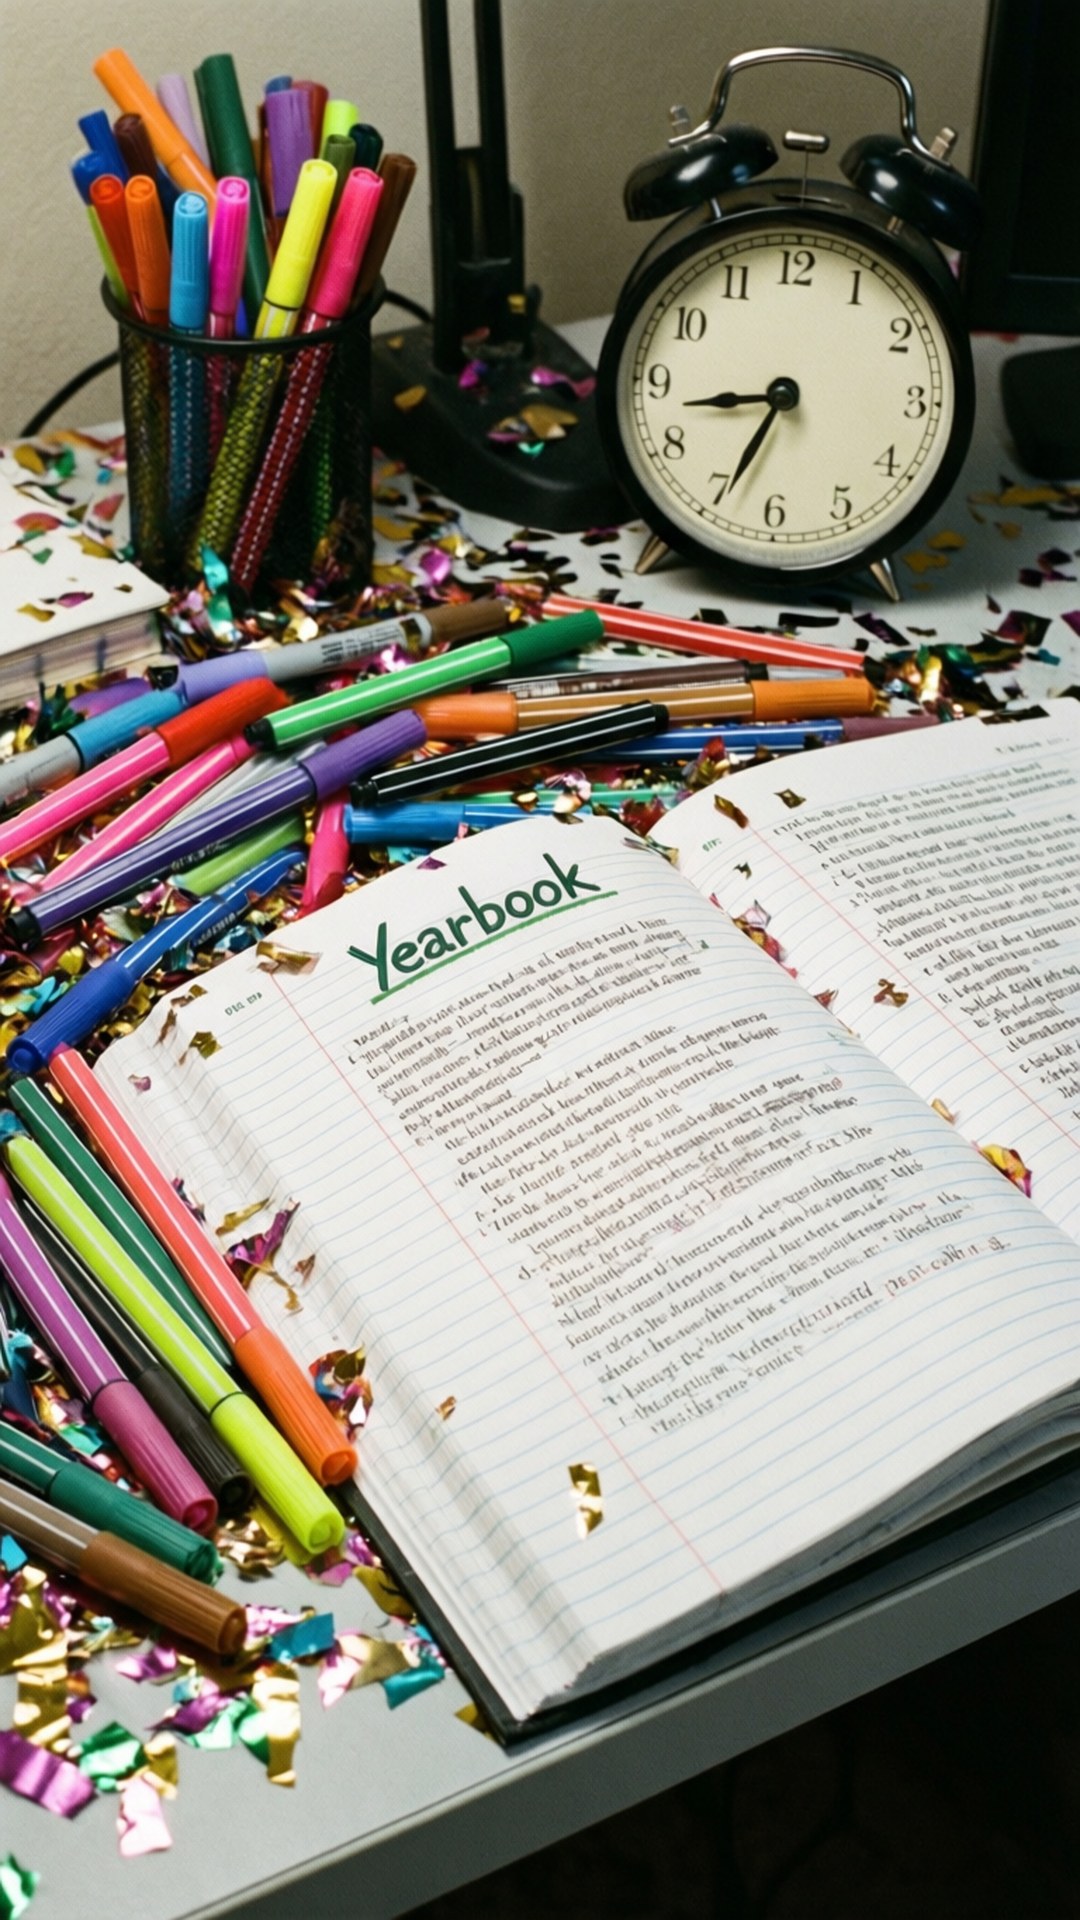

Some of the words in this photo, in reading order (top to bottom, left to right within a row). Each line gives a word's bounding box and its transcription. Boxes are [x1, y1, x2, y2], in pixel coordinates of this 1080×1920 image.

[721, 264, 750, 301] 11
[776, 250, 816, 287] 12
[847, 270, 863, 306] 1
[673, 306, 707, 342] 10
[888, 317, 913, 354] 2
[647, 364, 671, 399] 9
[903, 385, 927, 419] 3
[662, 425, 686, 460] 8
[873, 444, 901, 478] 4
[707, 472, 731, 505] 7
[830, 485, 852, 521] 5
[763, 494, 786, 528] 6
[347, 853, 602, 992] Yearbook
